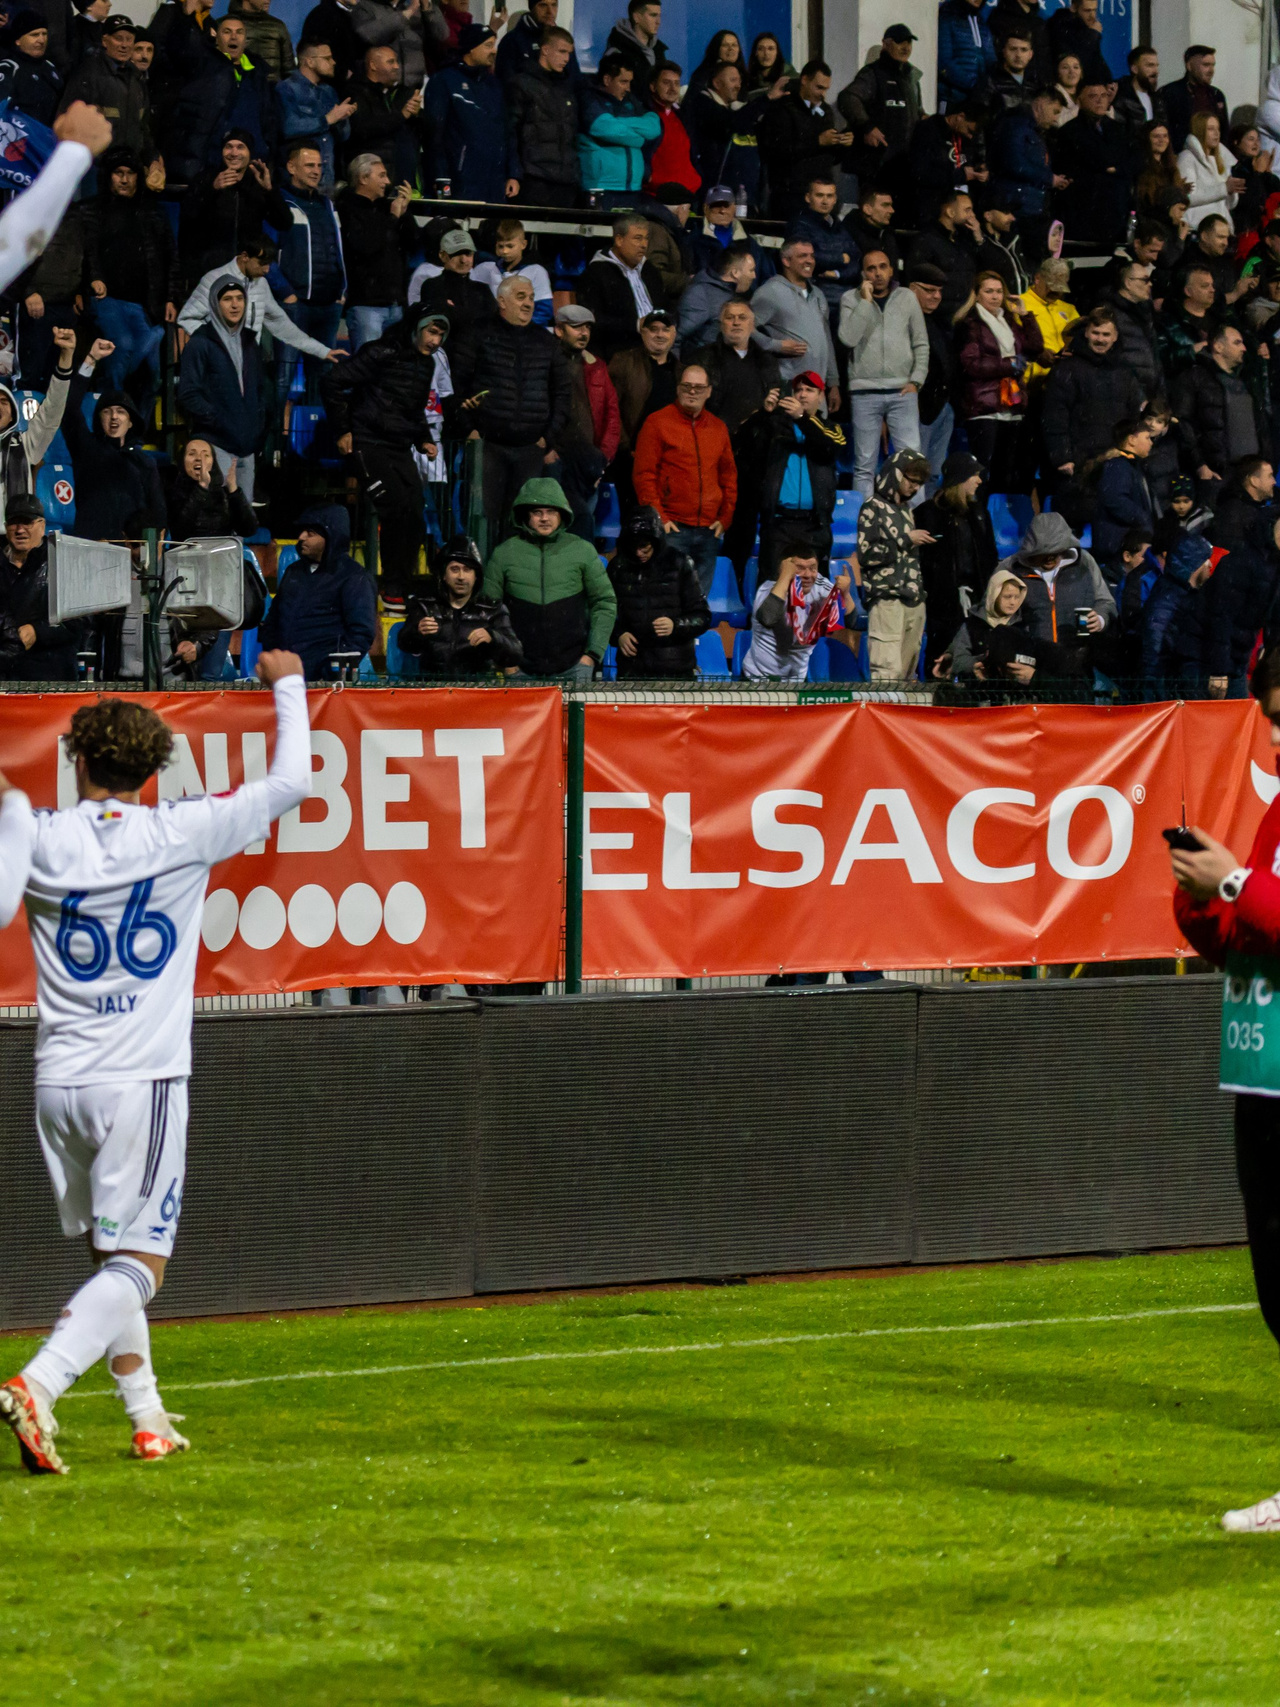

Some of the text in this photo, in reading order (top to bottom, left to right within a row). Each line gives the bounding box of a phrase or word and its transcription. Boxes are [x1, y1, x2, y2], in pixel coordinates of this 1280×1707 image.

[57, 728, 505, 855] NIBET
[56, 878, 178, 982] 66
[96, 995, 138, 1014] JALY
[1226, 1020, 1265, 1052] 035
[160, 1177, 183, 1224] 6
